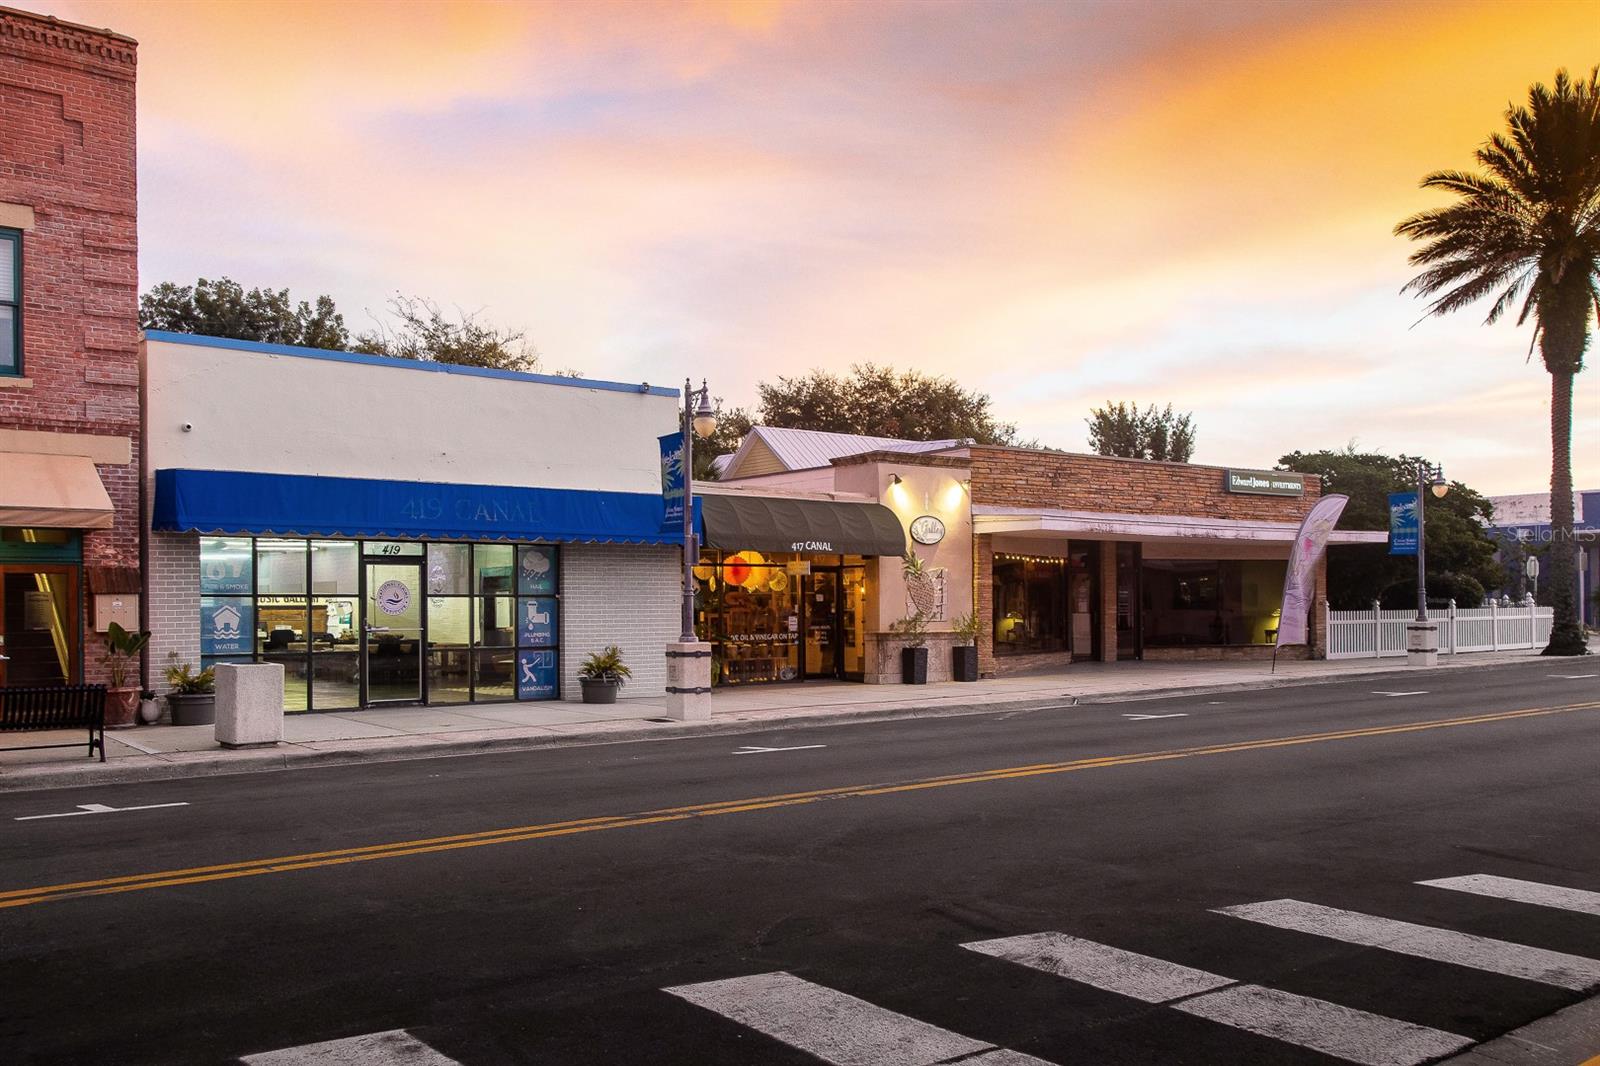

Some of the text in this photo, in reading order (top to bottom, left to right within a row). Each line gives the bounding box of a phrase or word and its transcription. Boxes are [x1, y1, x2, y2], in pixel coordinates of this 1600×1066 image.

[400, 496, 443, 520] 419
[381, 543, 401, 555] 419
[792, 541, 833, 551] 417 CANAL
[740, 633, 749, 641] OIL
[755, 633, 779, 641] VINEGAR
[788, 632, 799, 640] TAP
